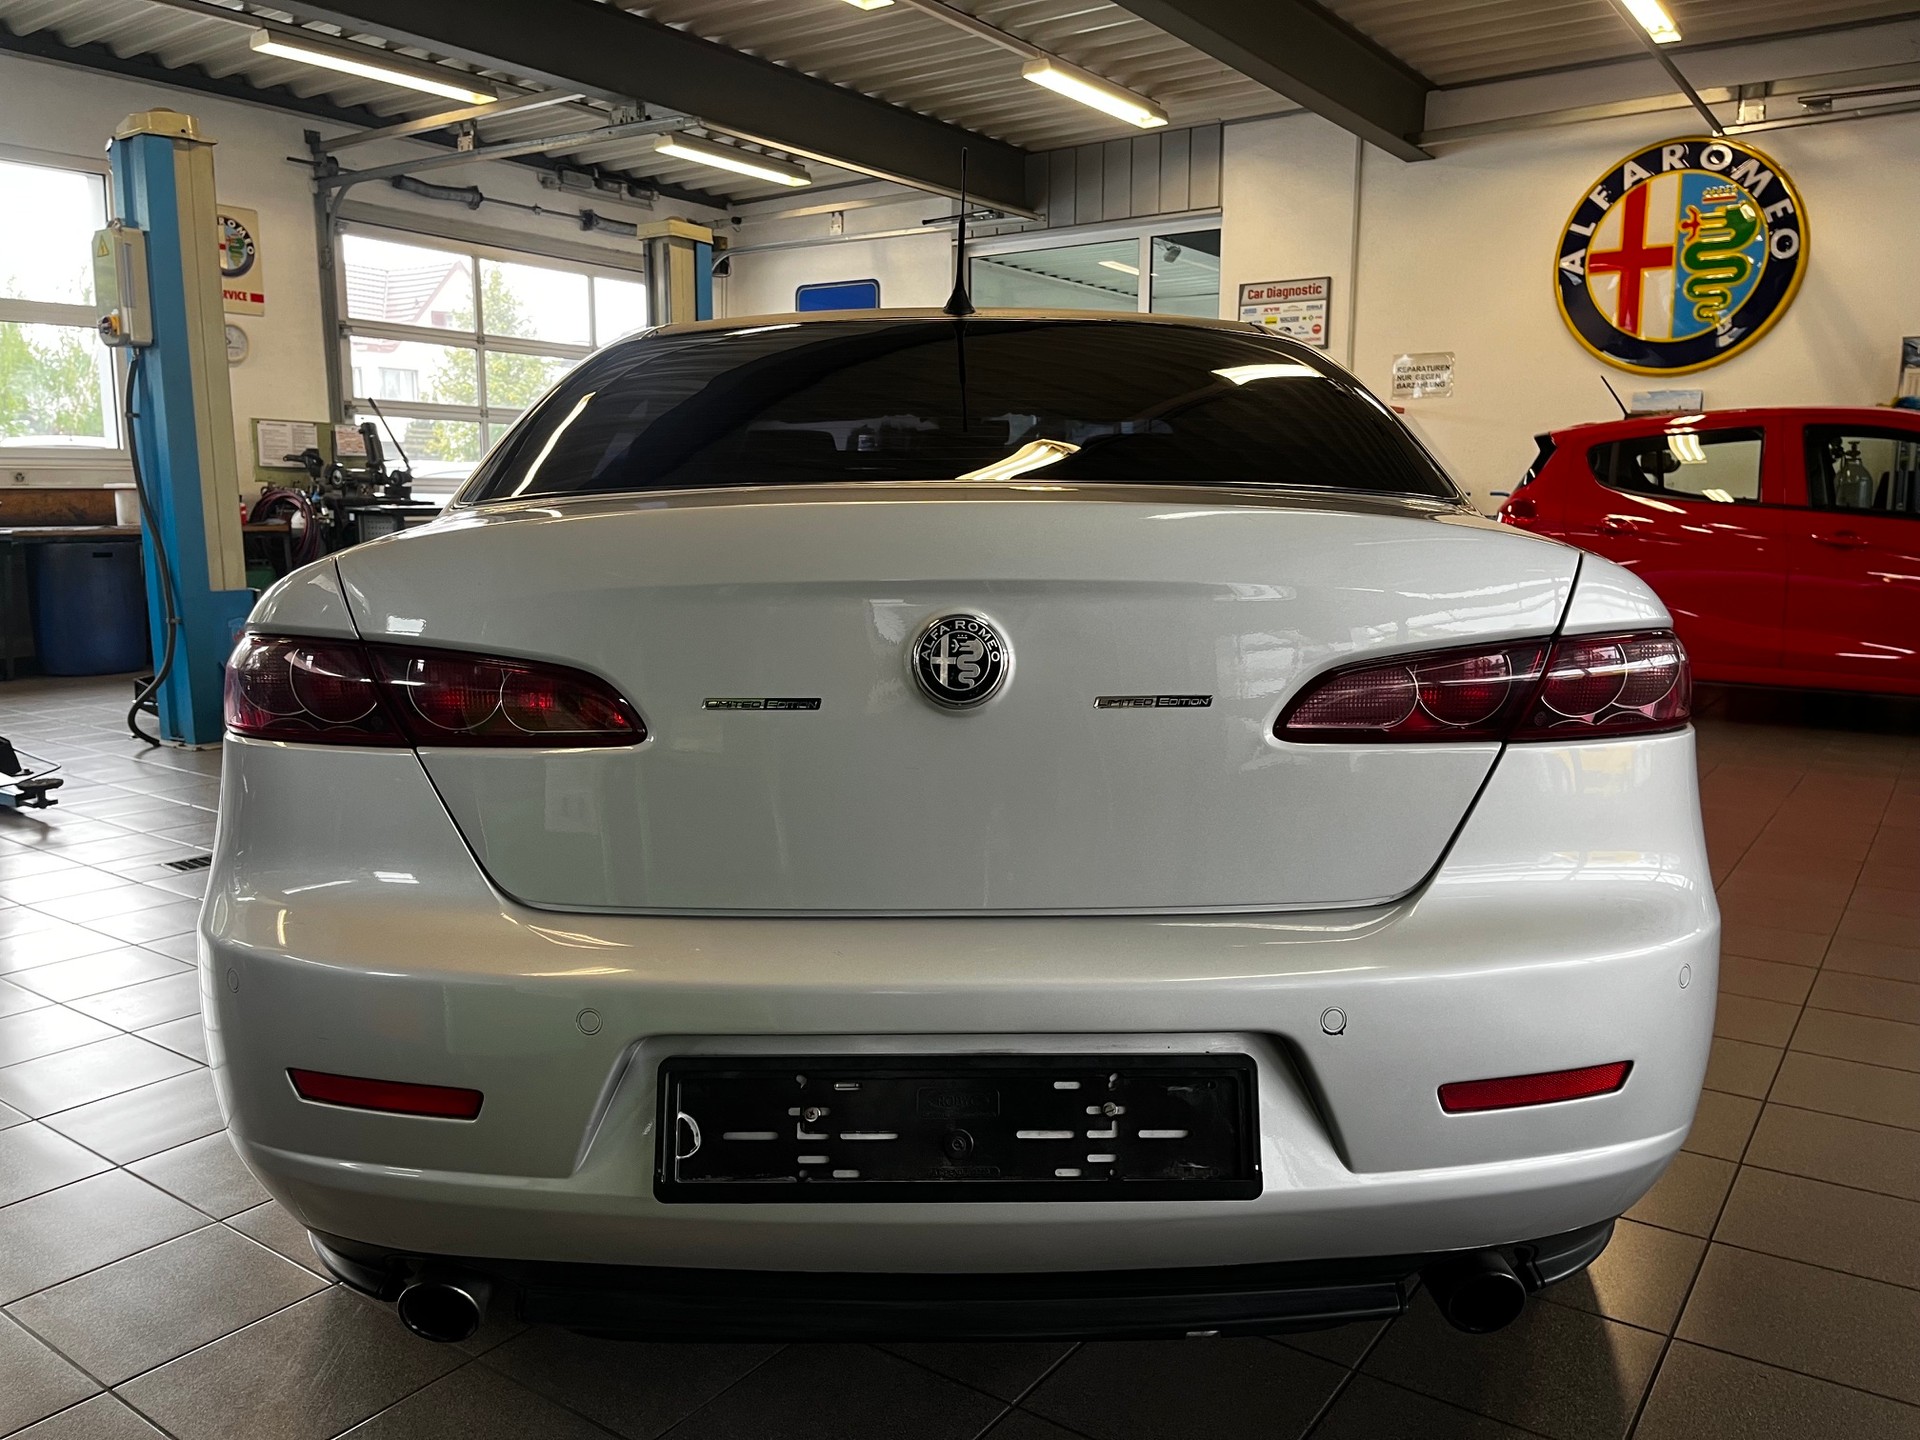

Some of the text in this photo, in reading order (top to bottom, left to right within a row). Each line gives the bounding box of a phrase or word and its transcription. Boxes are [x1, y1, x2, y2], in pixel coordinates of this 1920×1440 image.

[1560, 144, 1799, 275] ALFA ROMEO
[223, 290, 247, 302] RVICE
[1247, 283, 1322, 300] Car Diagnostic
[1397, 364, 1451, 373] REPARATUREN
[1415, 373, 1441, 381] GEGEN
[921, 620, 1000, 662] ALFA ROMEO
[1098, 697, 1210, 707] LIMITED EDITION
